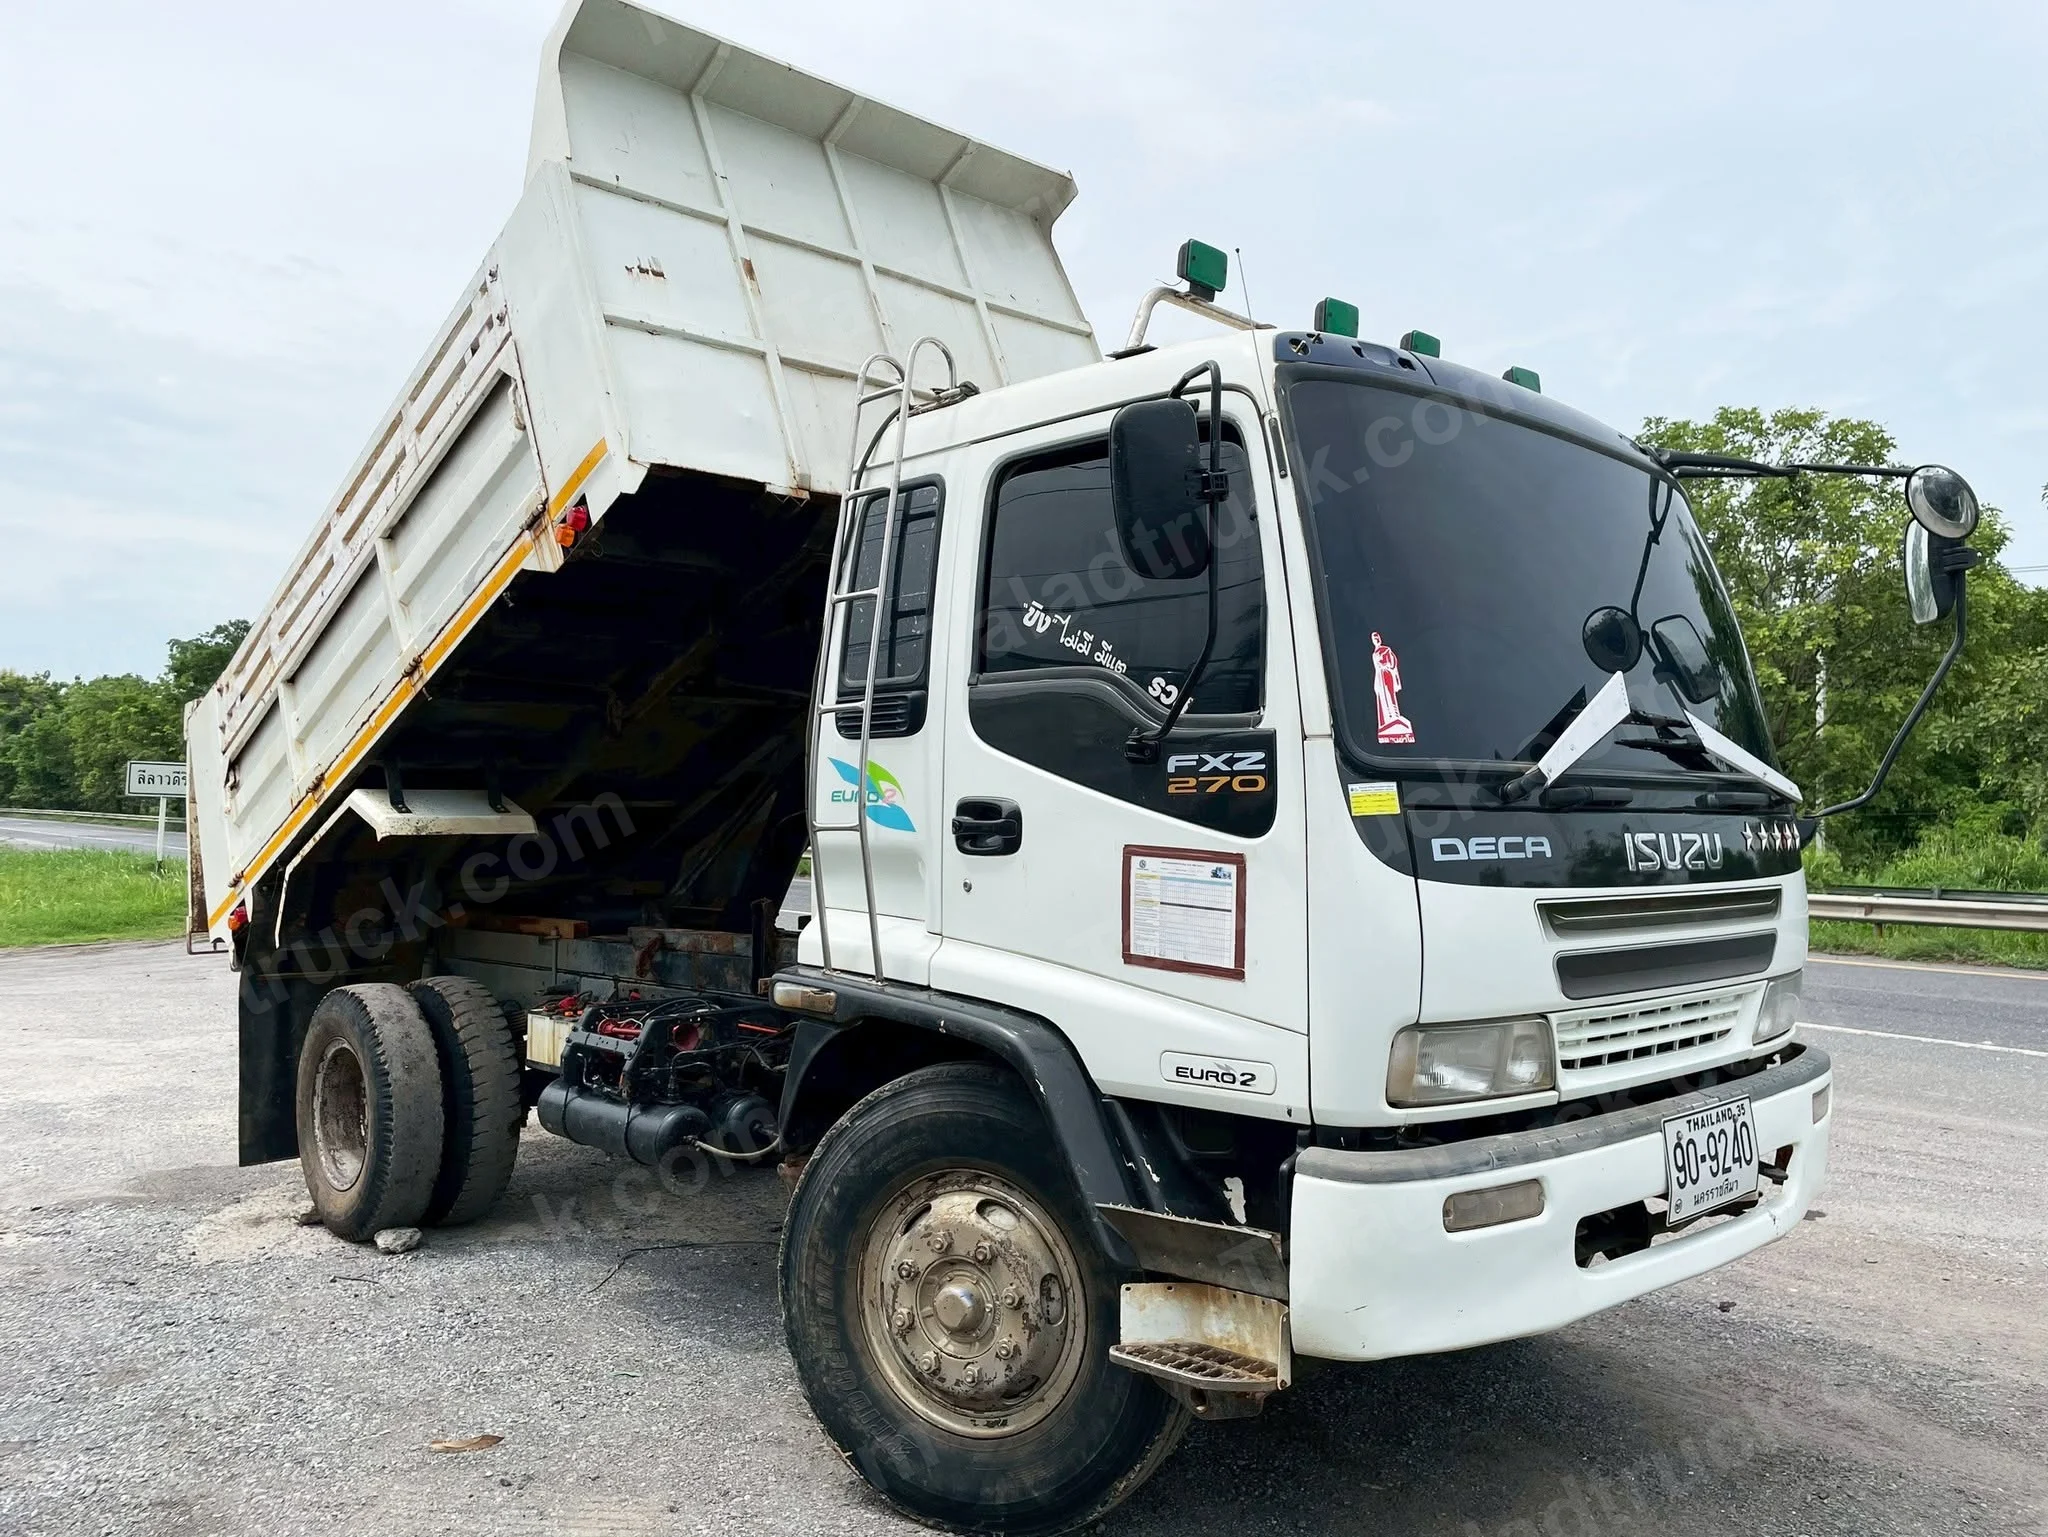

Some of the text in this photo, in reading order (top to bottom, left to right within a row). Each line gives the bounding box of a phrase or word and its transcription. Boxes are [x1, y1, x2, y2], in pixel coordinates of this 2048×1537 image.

[1167, 751, 1266, 773] FXZ
[1167, 775, 1266, 794] 270
[1431, 836, 1552, 861] DECA
[1624, 832, 1723, 872] ISUZU
[1686, 1107, 1733, 1133] THAILAND
[1673, 1121, 1753, 1190] 90-9240
[1694, 1178, 1739, 1206] นครราชสีมา
